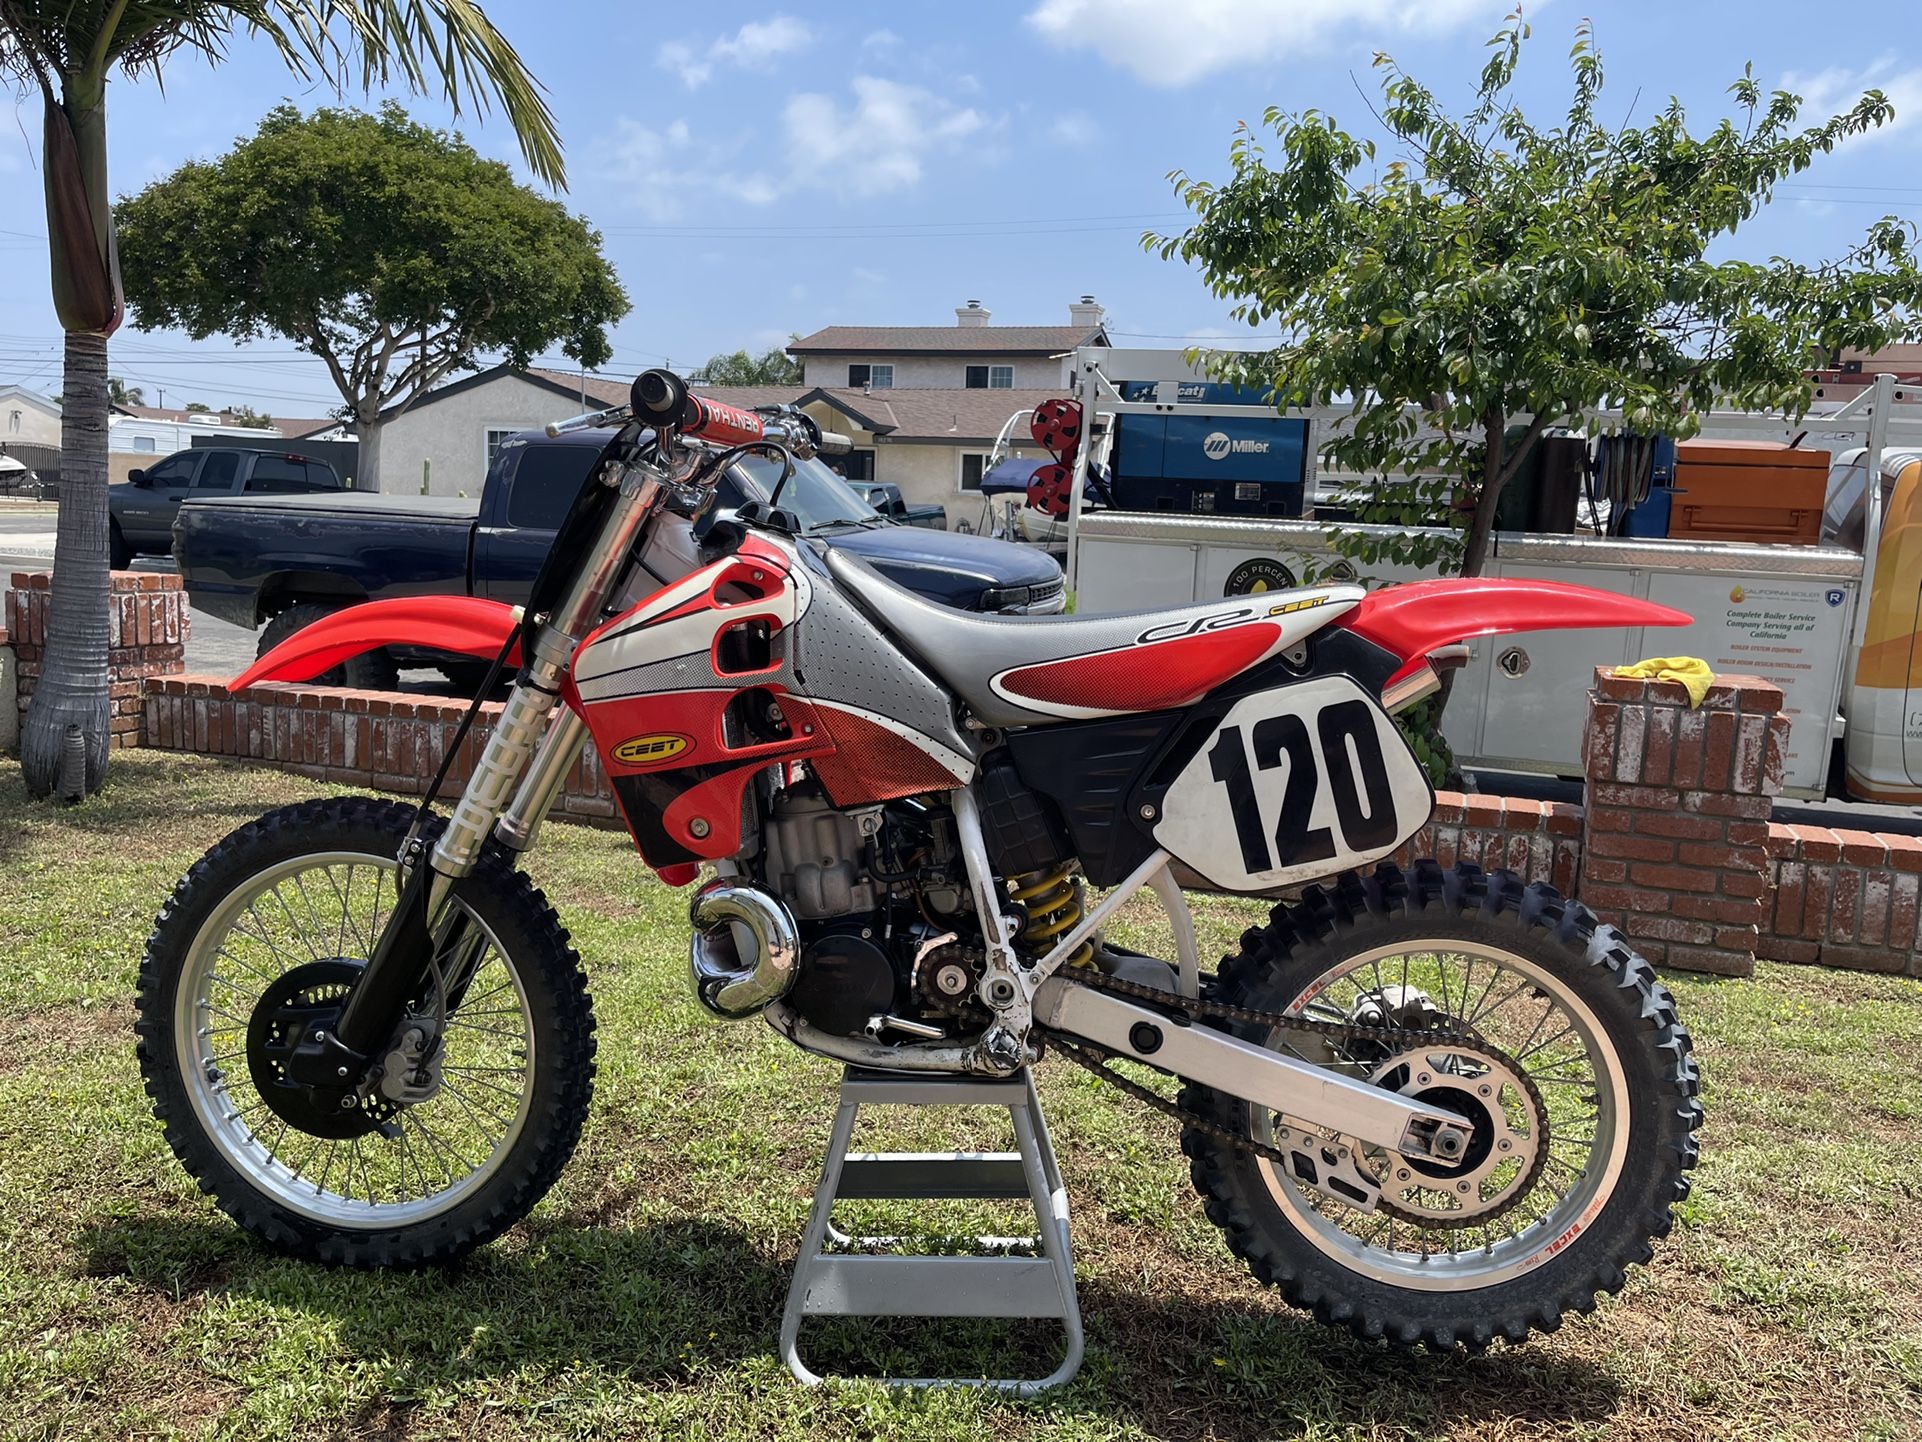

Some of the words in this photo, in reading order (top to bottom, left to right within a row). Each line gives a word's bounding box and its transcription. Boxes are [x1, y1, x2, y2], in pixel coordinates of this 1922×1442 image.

[1232, 440, 1269, 453] Miller
[1233, 570, 1249, 588] 100
[1251, 565, 1291, 588] PERCEN
[1726, 609, 1762, 620] Complete
[1763, 611, 1787, 621] Boiler
[1788, 612, 1816, 622] Service
[1726, 619, 1761, 630] Company
[1763, 621, 1792, 632] Serving
[1793, 623, 1805, 631] all
[1805, 623, 1815, 631] of
[1749, 630, 1787, 640] California
[620, 738, 680, 758] CEET
[1207, 699, 1399, 875] 120
[1544, 1222, 1581, 1255] EXCEL
